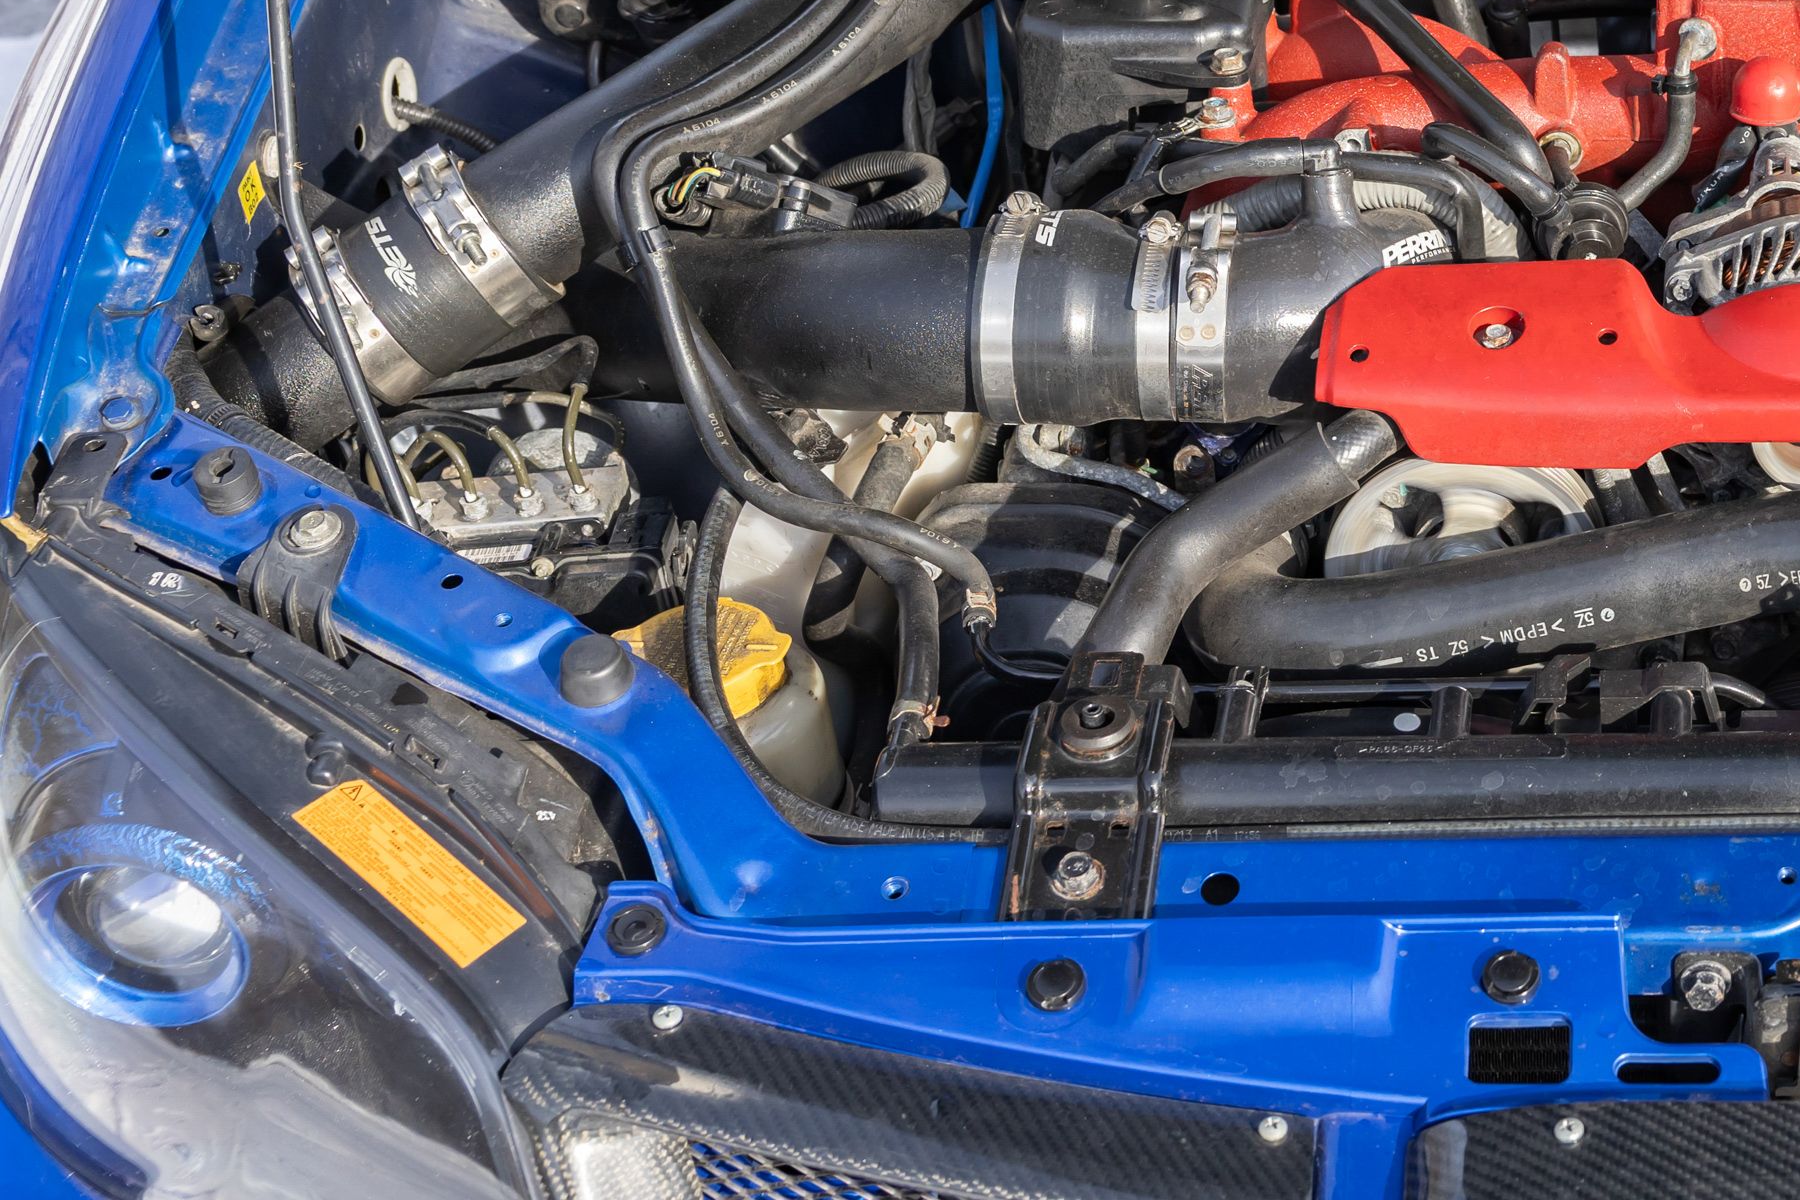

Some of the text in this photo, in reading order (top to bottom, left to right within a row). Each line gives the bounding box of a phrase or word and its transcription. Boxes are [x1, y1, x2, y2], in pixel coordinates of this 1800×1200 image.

[837, 26, 862, 51] 6104
[769, 79, 798, 101] 6104
[691, 117, 721, 133] 6104
[1382, 229, 1450, 269] PERRIN
[1756, 574, 1772, 590] 5Z
[1416, 646, 1440, 663] TS
